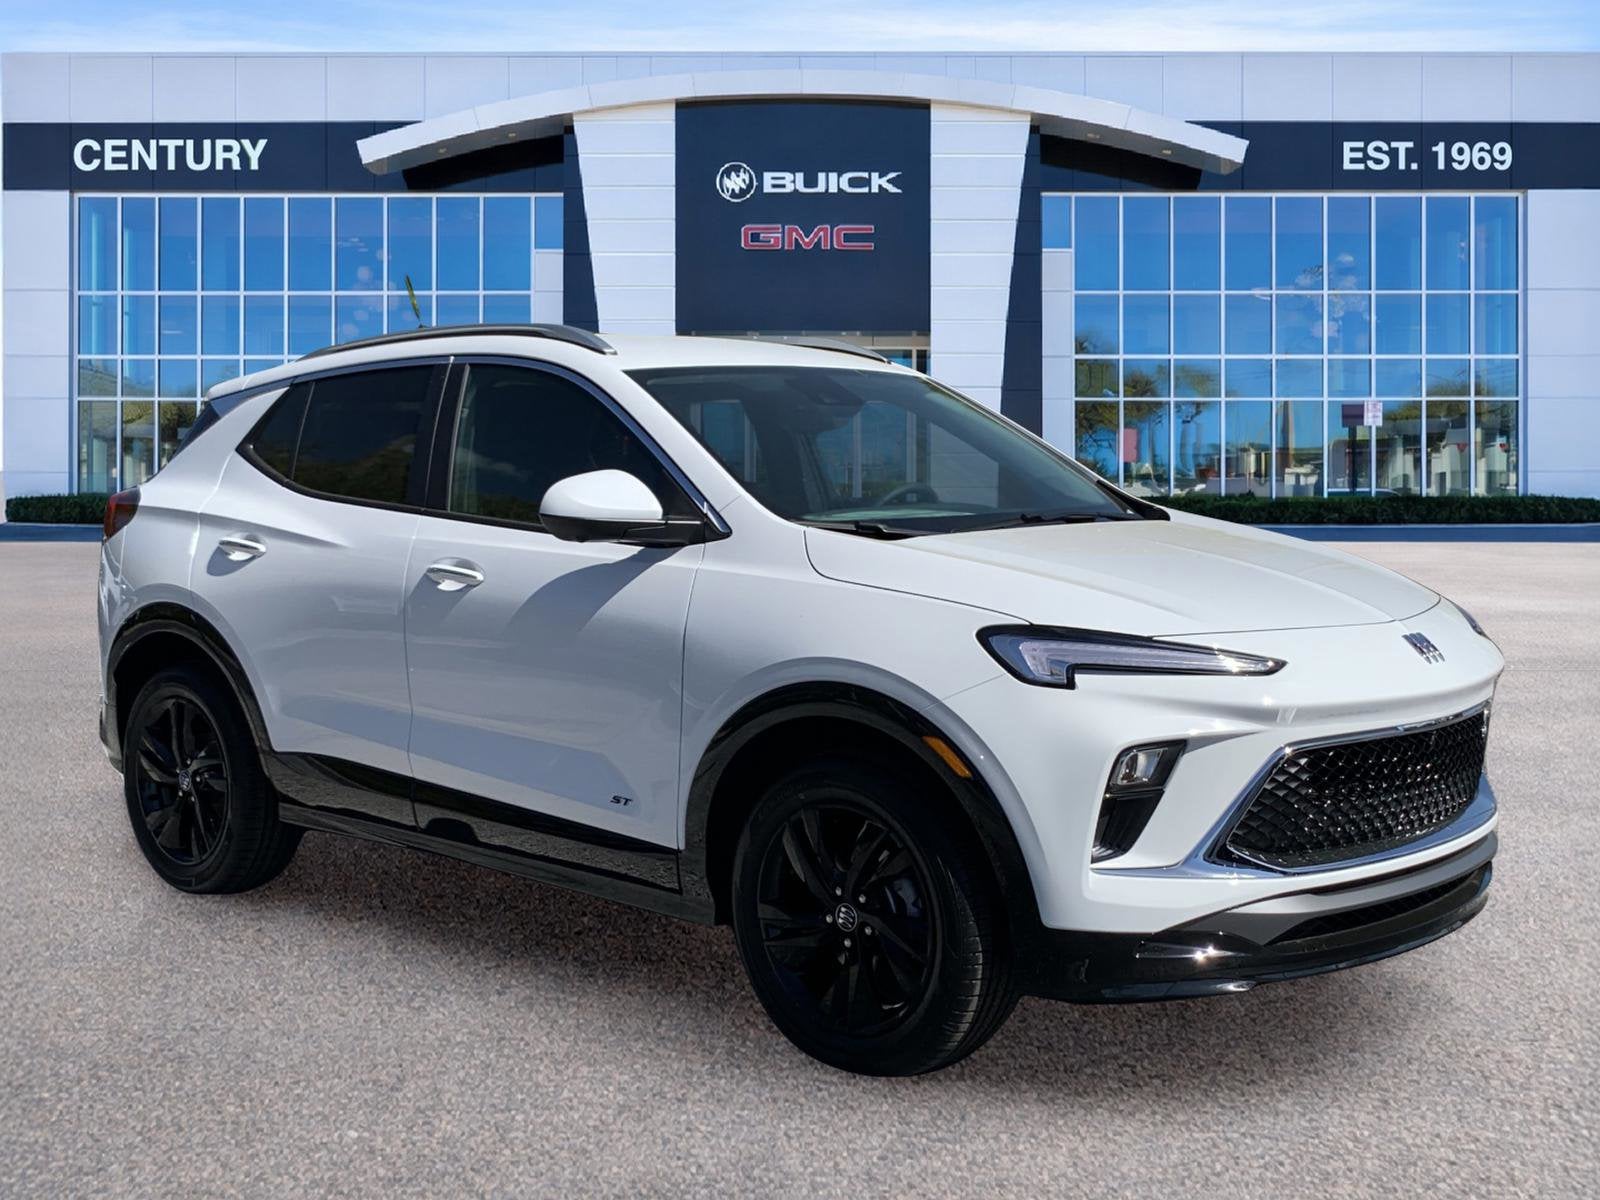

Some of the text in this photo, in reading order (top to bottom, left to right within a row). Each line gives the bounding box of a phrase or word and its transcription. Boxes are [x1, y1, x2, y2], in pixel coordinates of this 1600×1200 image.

[73, 138, 268, 172] CENTURY
[1342, 140, 1513, 171] EST. 1969
[762, 171, 903, 194] BUICK
[740, 223, 875, 251] GMC
[610, 795, 633, 806] ST
